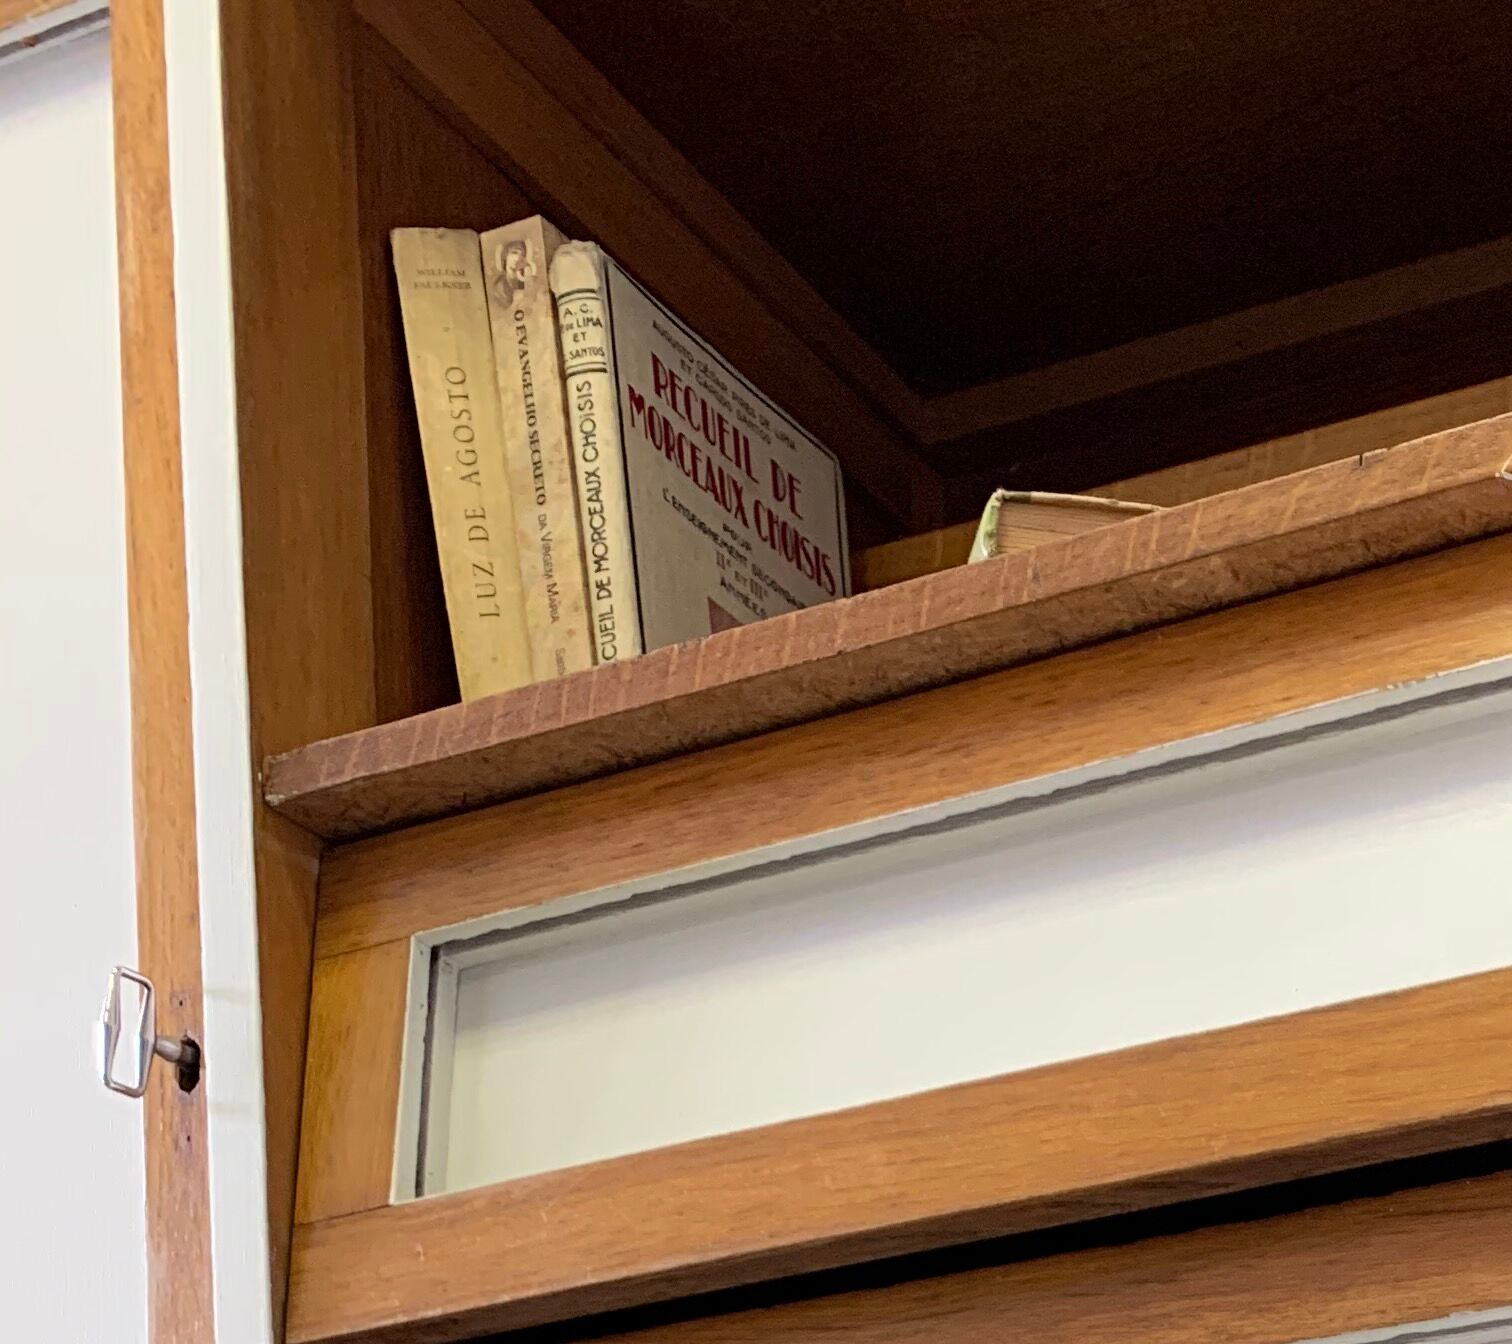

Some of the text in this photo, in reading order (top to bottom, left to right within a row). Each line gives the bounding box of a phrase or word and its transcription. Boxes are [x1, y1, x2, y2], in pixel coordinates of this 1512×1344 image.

[514, 309, 525, 322] O
[573, 331, 587, 342] ET
[576, 316, 603, 328] LIMA
[516, 326, 537, 427] EVANGELHO
[528, 430, 547, 506] SECRETO
[651, 351, 803, 520] RECUEIL DE
[445, 366, 500, 618] LUZ DE AGOSTO
[584, 467, 610, 573] MORCEAUX
[627, 384, 837, 597] MORCEAUX CHOISIS
[595, 575, 612, 601] DE
